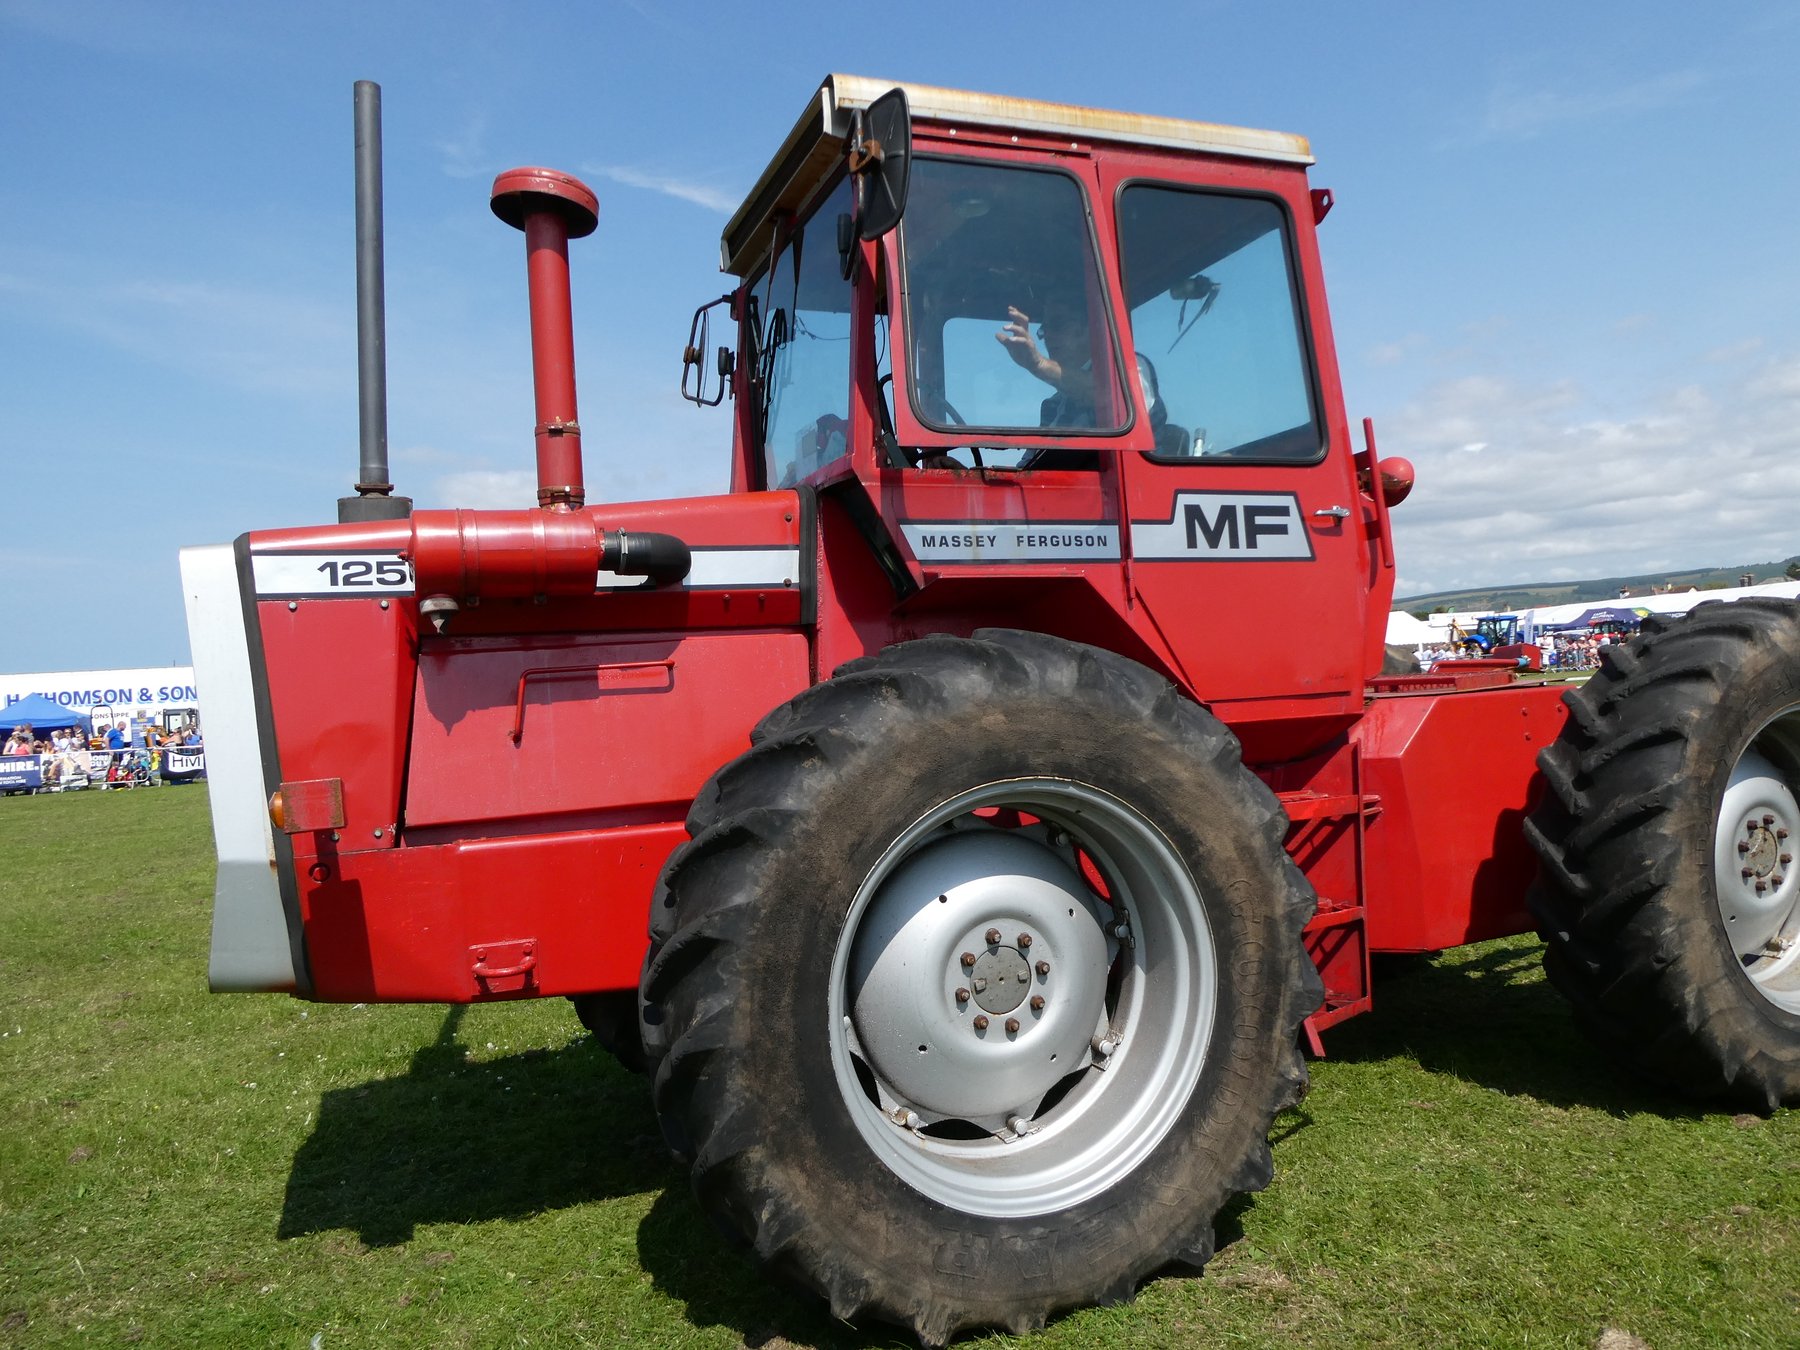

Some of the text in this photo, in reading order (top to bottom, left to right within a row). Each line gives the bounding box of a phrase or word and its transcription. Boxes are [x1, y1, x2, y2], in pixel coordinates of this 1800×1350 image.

[1184, 504, 1290, 549] MF
[922, 534, 1108, 548] MASSEY FERGUSON
[317, 561, 414, 586] 125
[37, 689, 132, 706] HOMSON
[139, 687, 153, 702] &
